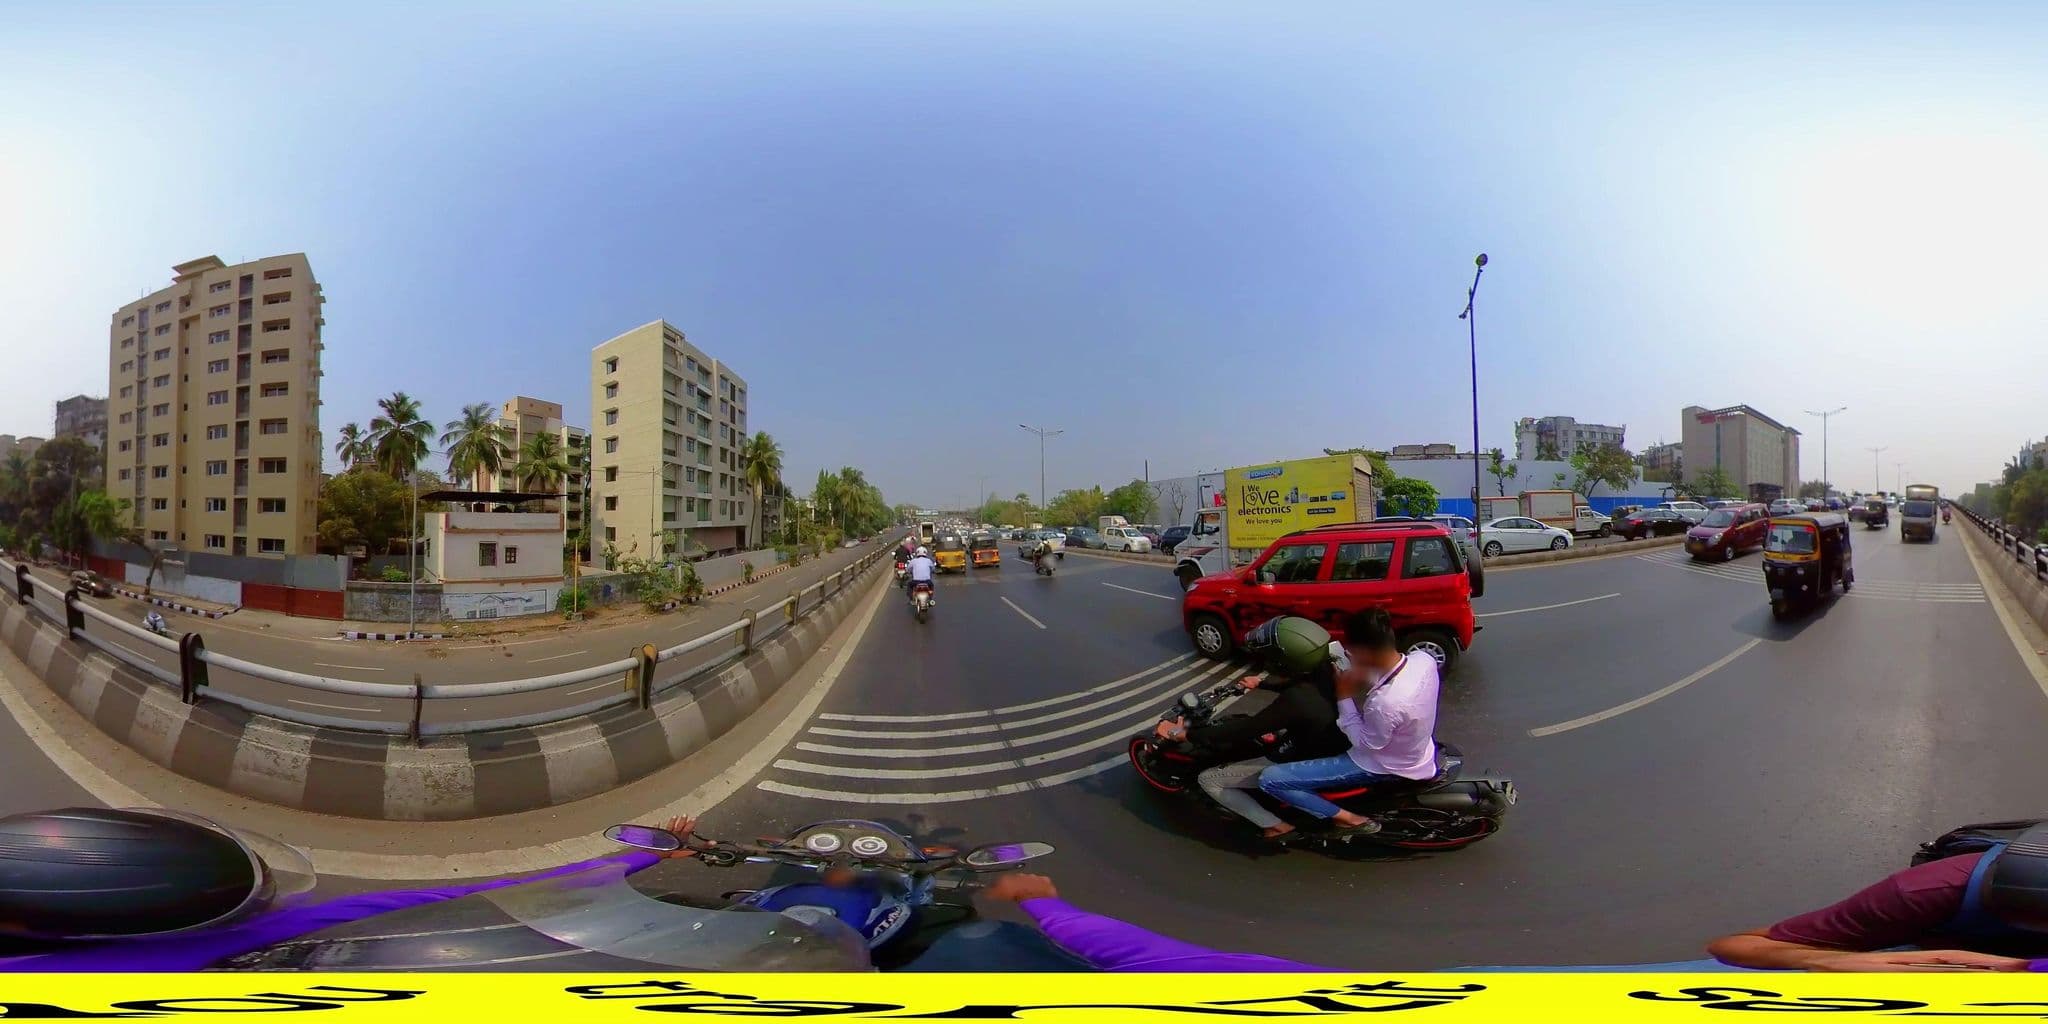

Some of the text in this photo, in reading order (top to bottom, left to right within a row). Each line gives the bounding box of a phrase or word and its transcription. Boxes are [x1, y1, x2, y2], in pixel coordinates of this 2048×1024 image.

[1248, 484, 1260, 492] We
[1242, 485, 1279, 508] love
[1238, 504, 1291, 515] electronics
[1271, 518, 1283, 526] you
